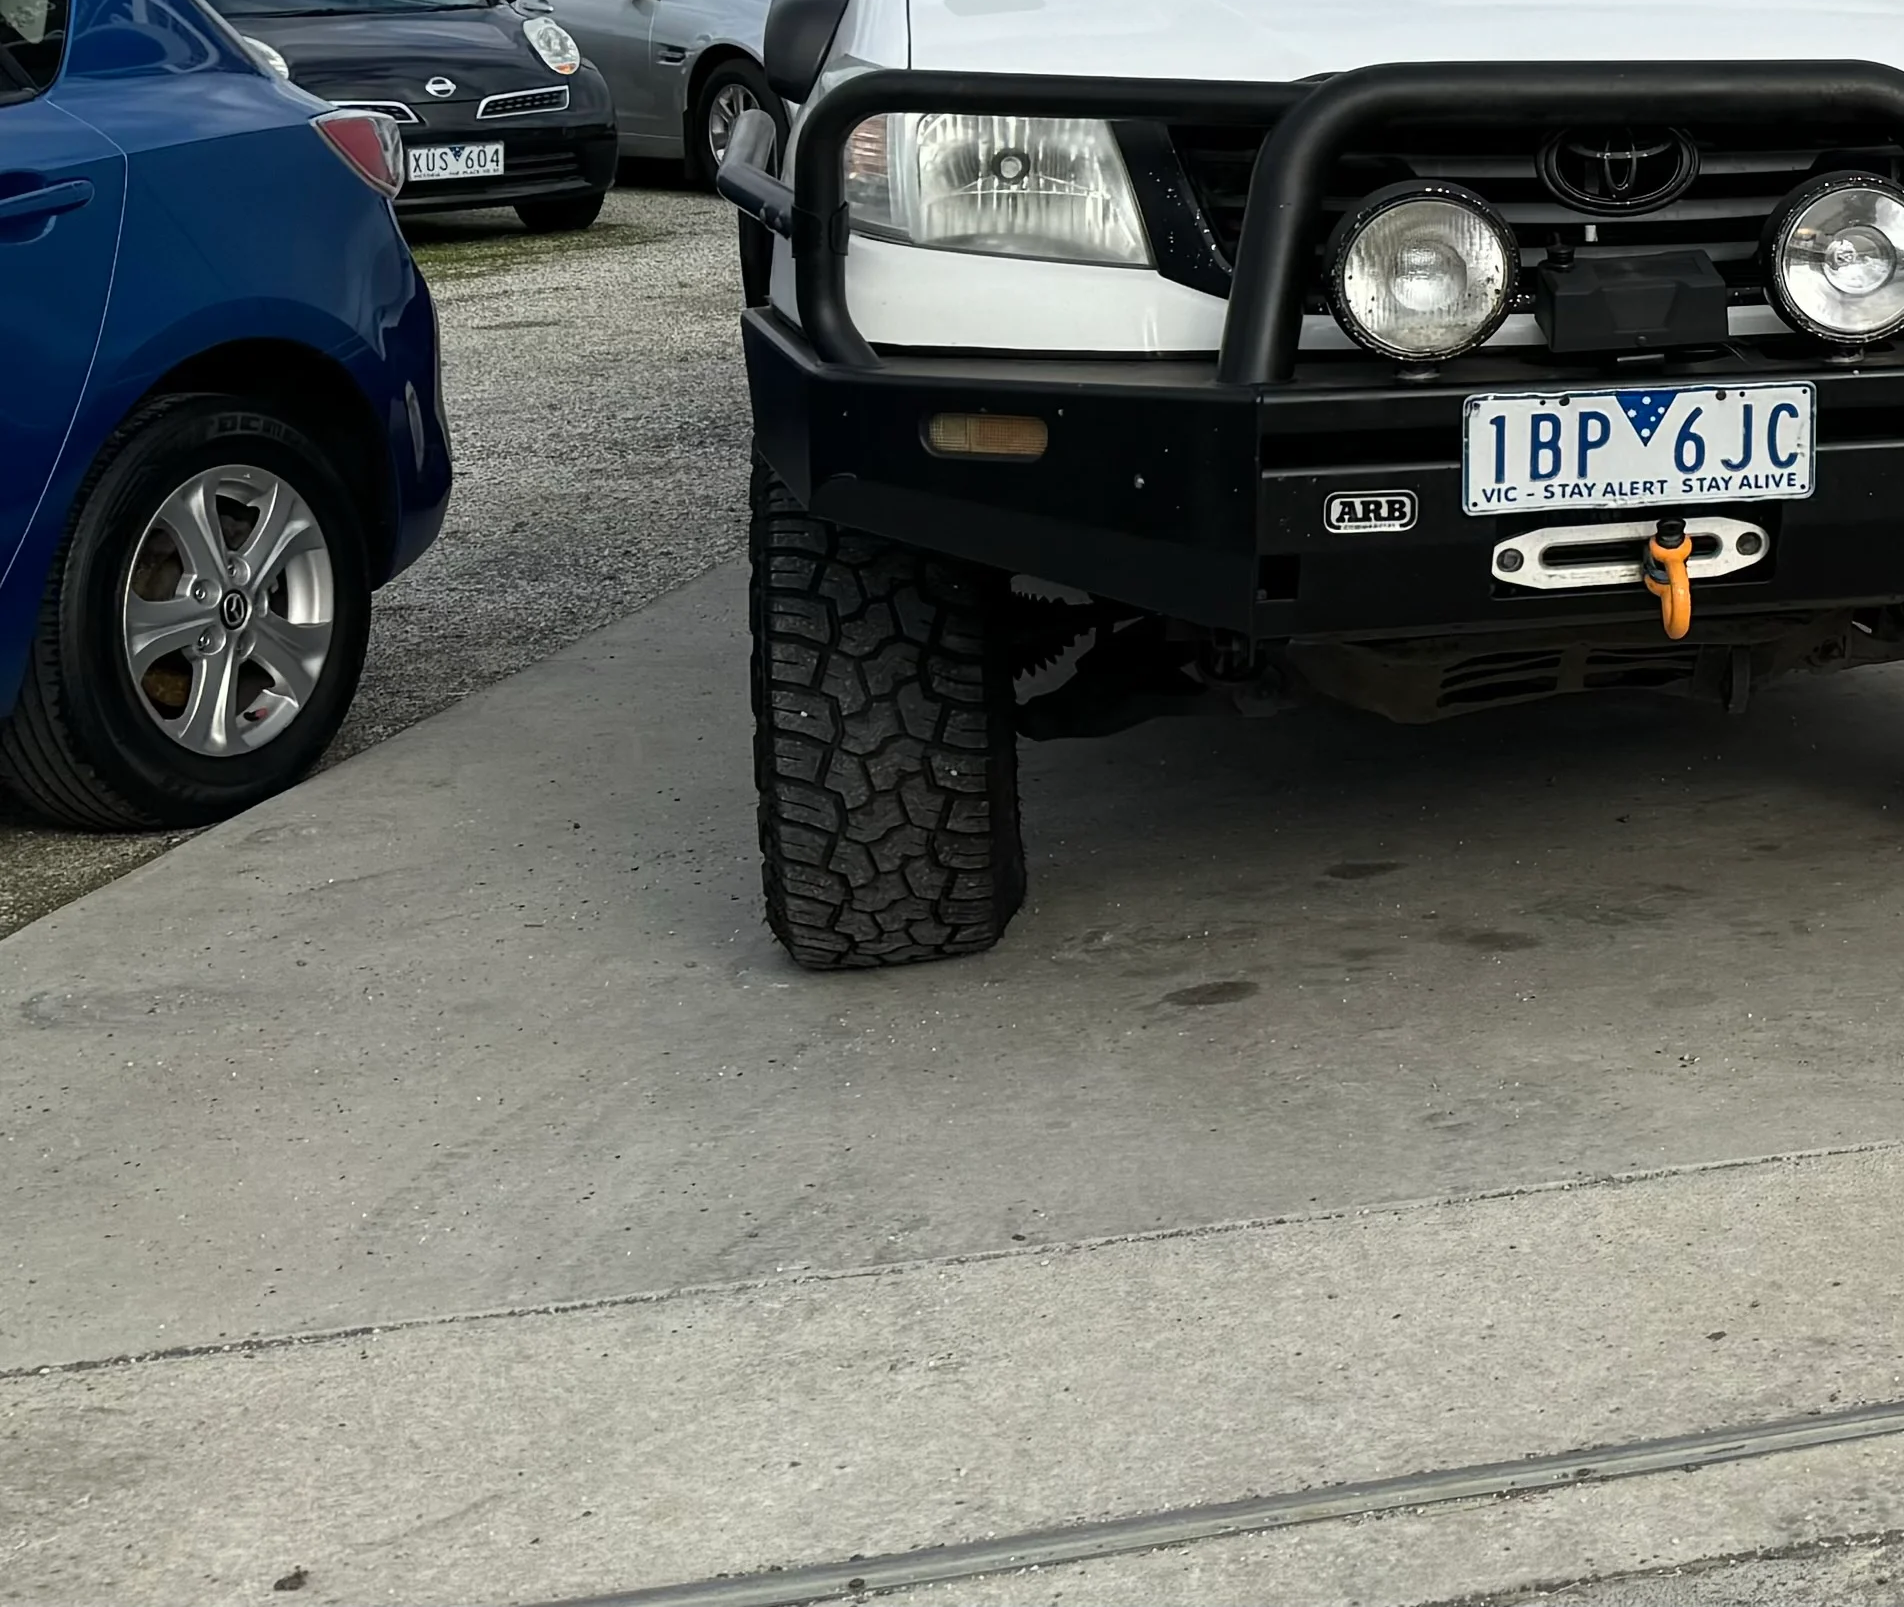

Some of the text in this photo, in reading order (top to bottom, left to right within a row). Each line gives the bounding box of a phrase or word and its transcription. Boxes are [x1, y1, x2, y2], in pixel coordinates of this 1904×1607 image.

[412, 147, 500, 173] XUS 604
[1488, 402, 1800, 485] 1BP 6JC
[1482, 486, 1517, 503] VIC
[1544, 482, 1596, 499] STAY
[1602, 479, 1669, 496] ALERT
[1681, 476, 1732, 493] STAY
[1738, 471, 1798, 489] ALIVE
[1335, 499, 1408, 524] ARB
